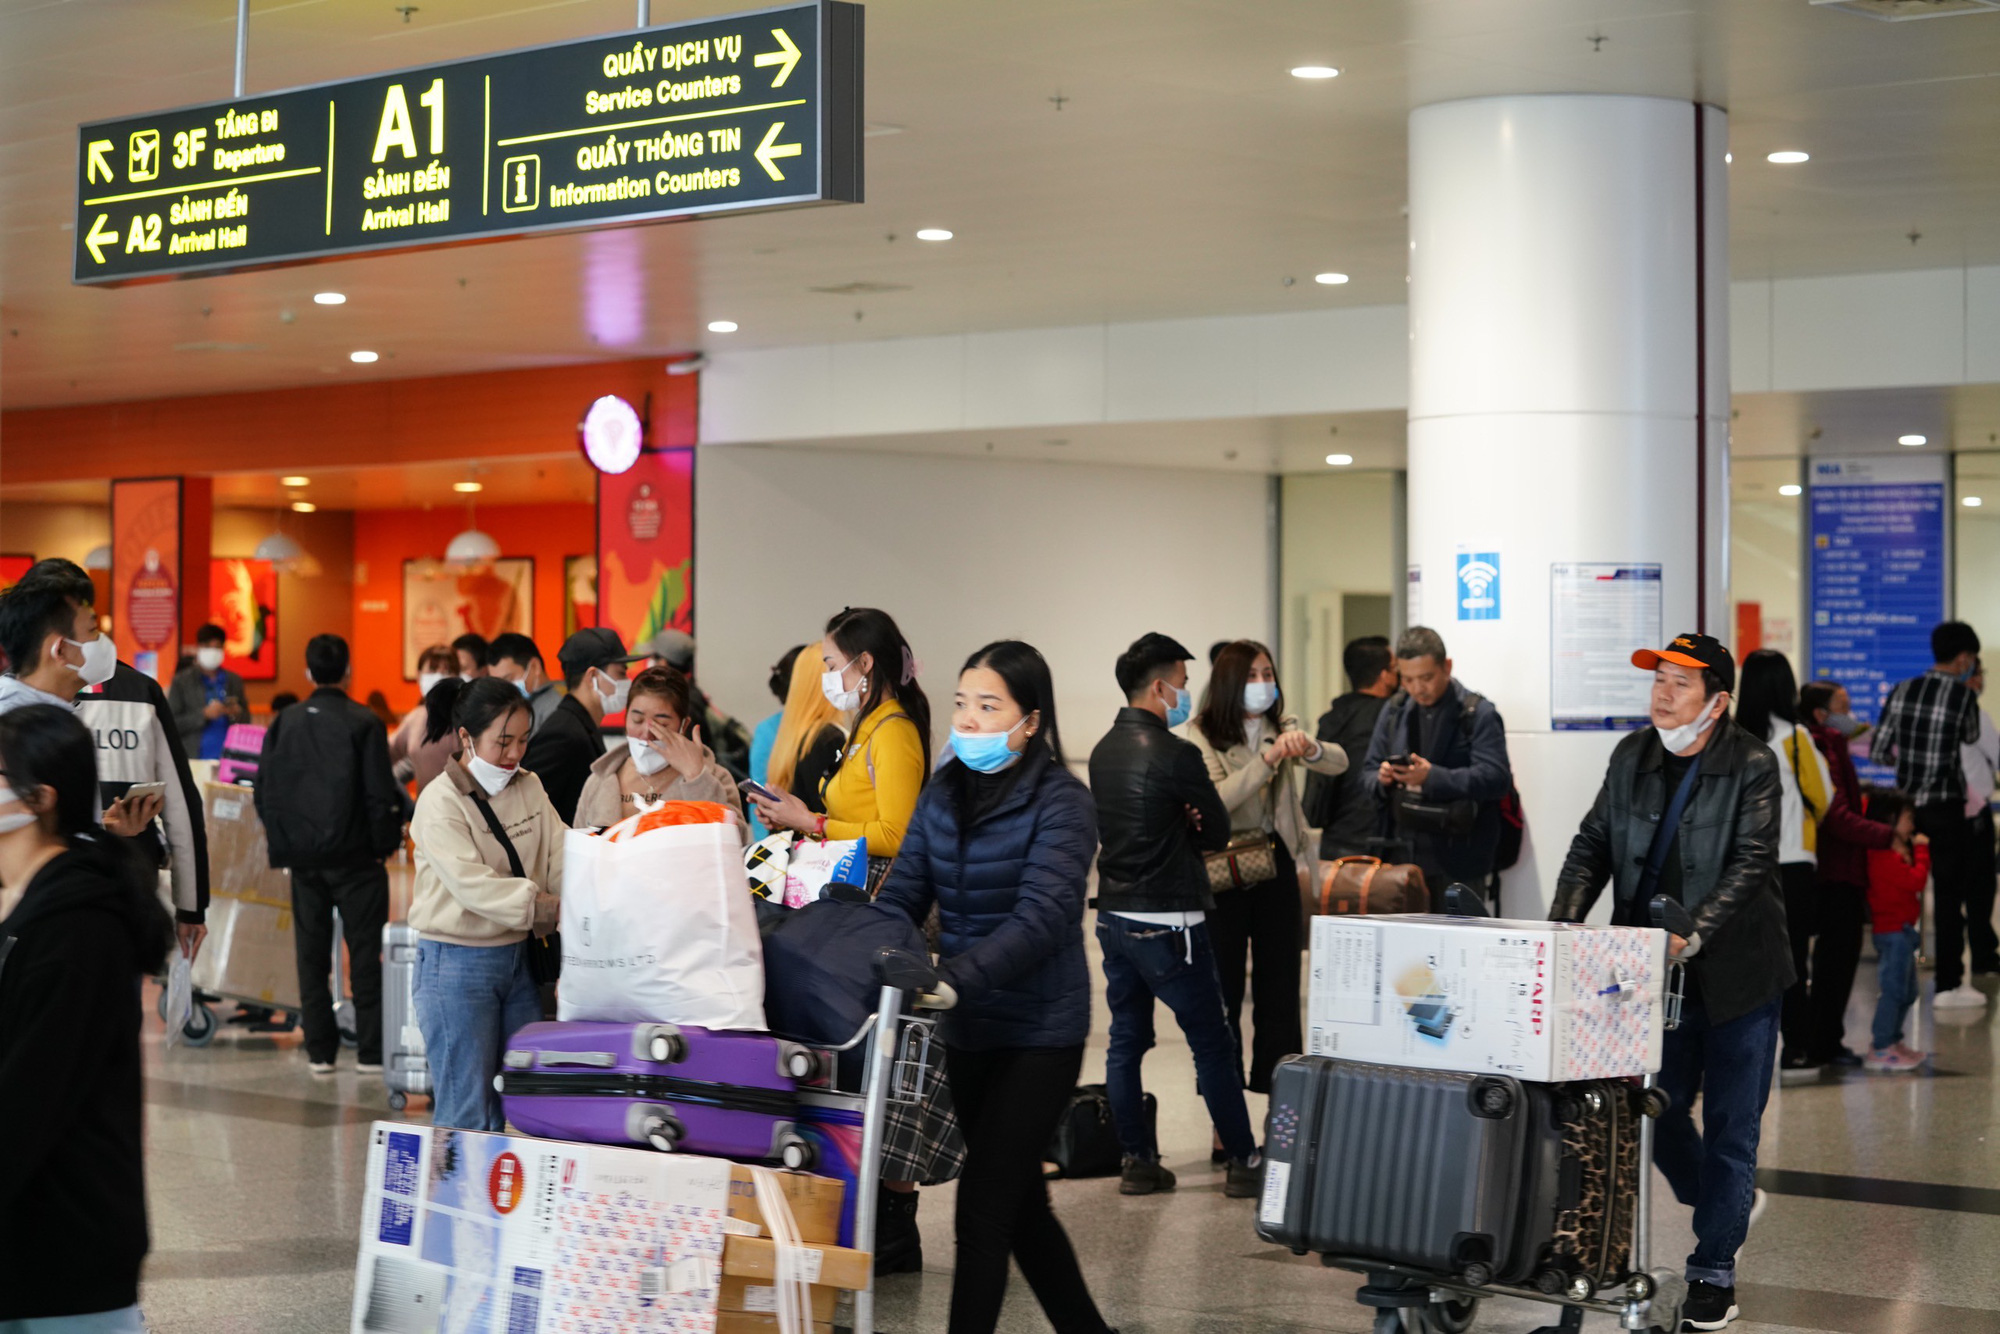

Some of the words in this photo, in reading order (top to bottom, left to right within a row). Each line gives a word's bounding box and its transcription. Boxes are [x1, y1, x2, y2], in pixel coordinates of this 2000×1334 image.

[661, 40, 709, 71] DỊCH
[713, 34, 742, 63] VỤ
[585, 86, 653, 114] Service
[656, 75, 741, 105] Counters
[261, 109, 278, 133] ĐI
[372, 78, 444, 163] A1
[172, 128, 207, 169] 3F
[213, 143, 285, 172] Departure
[634, 130, 704, 164] THÔNG
[708, 127, 741, 154] TIN
[363, 168, 410, 199] SẢNH
[413, 159, 450, 193] ĐẾN
[550, 176, 650, 208] Information
[655, 167, 741, 196] Counters
[170, 195, 212, 225] SẢNH
[214, 187, 248, 219] ĐẾN
[361, 203, 414, 231] Arrival
[417, 199, 450, 224] Hall
[125, 214, 162, 254] A2
[168, 229, 216, 255] Arrival
[218, 225, 247, 248] Hall
[1530, 941, 1547, 1036] SHARP
